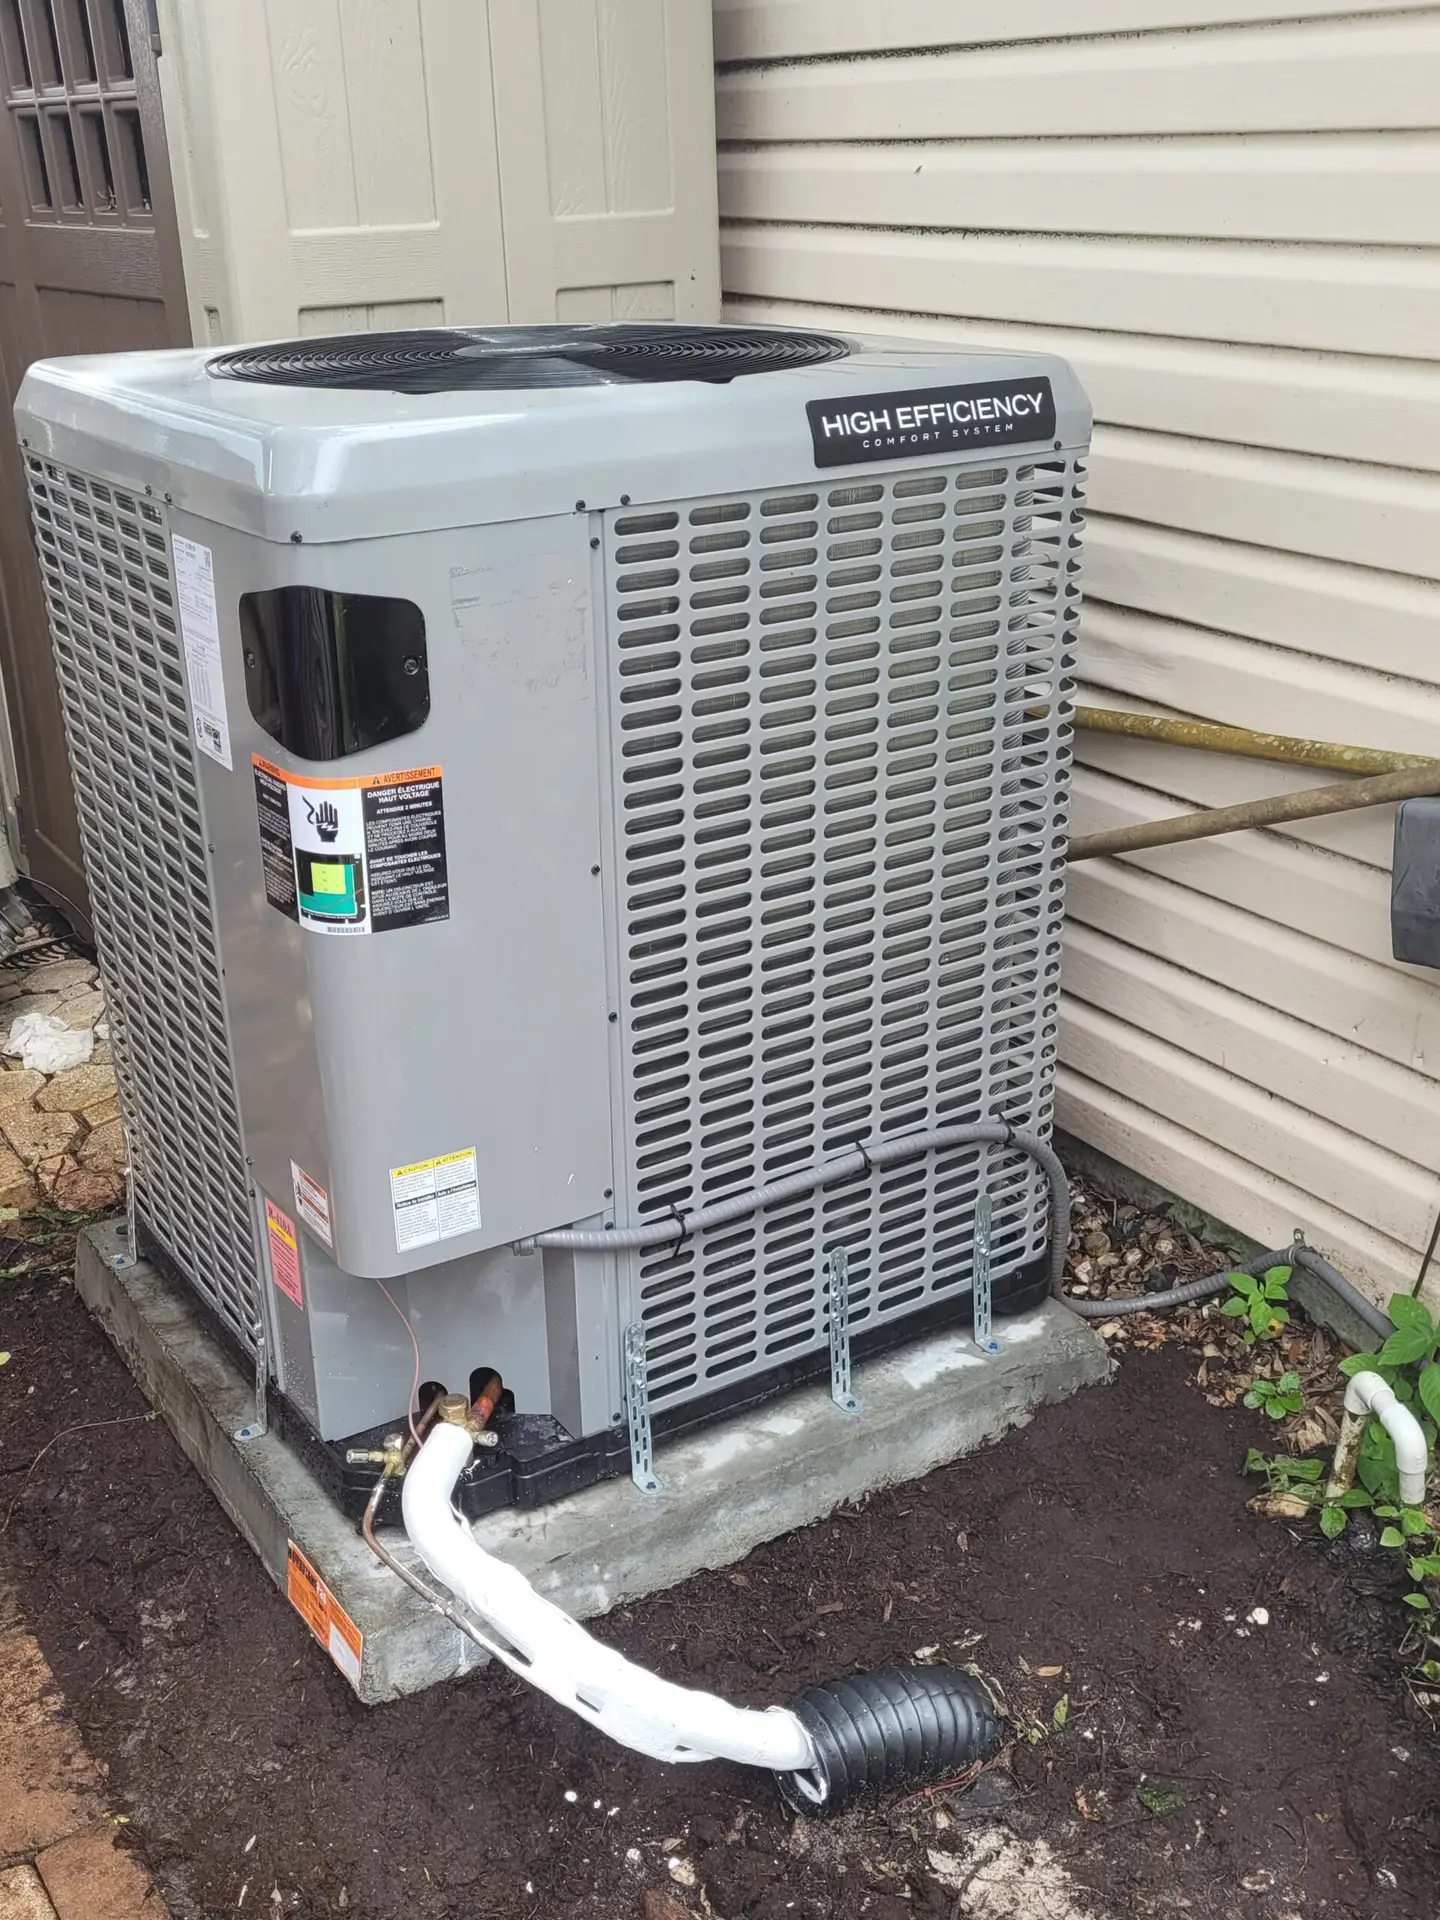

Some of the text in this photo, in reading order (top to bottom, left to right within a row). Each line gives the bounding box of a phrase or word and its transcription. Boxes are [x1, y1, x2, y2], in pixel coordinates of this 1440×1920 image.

[822, 393, 1042, 437] HIGH EFFICIENCY
[863, 423, 1013, 448] COMFORT SYSTEM
[384, 768, 435, 783] AVERTISSEMENT
[367, 782, 439, 798] DANGER ÉLECTRIQUE
[399, 790, 429, 800] VOLTAGE
[377, 806, 404, 814] ATTENDRE
[410, 801, 432, 809] MINUTES
[442, 1151, 472, 1163] ATTENTION
[403, 1164, 429, 1173] CAUTION
